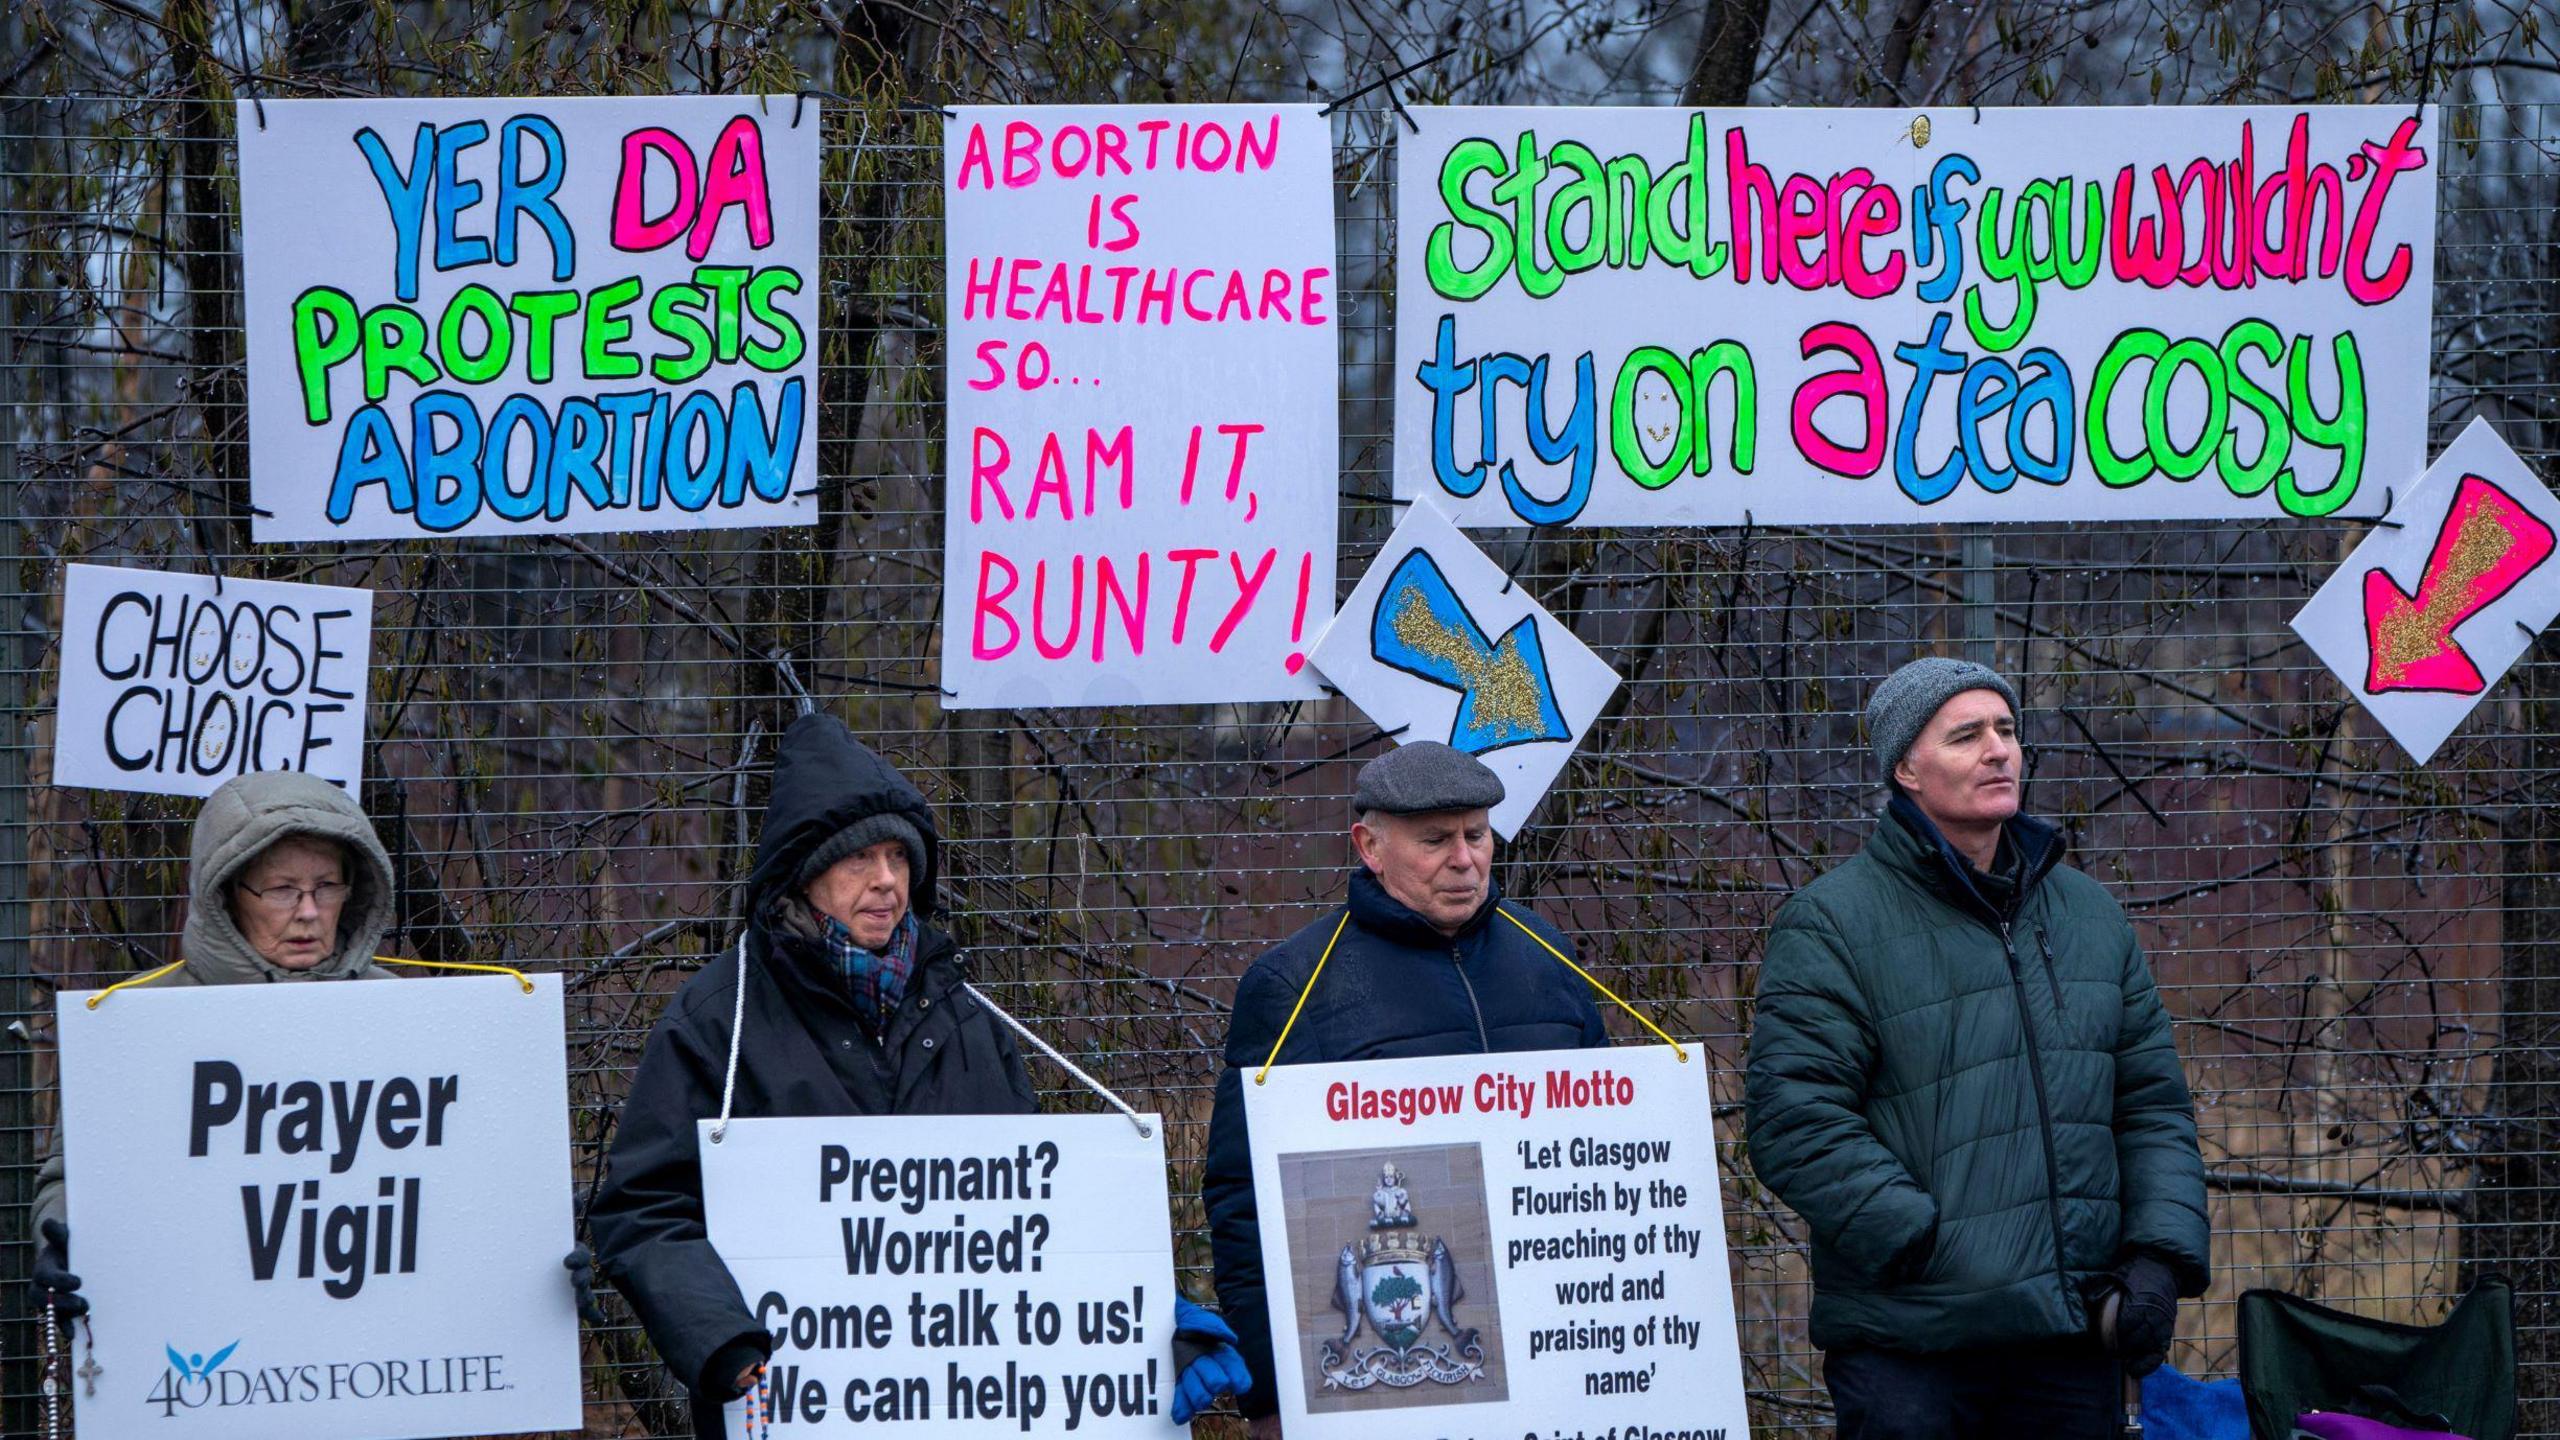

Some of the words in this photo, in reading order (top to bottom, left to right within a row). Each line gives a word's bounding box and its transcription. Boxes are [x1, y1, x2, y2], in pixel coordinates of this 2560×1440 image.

[957, 114, 1280, 189] ABORTION
[353, 114, 575, 302] YER
[610, 114, 774, 261] DA
[1088, 194, 1141, 252] IS
[1425, 111, 1729, 301] Stand
[1725, 127, 1907, 299] here
[1964, 175, 2106, 352] you
[2110, 113, 2428, 305] wouldn't
[964, 256, 1330, 325] HEALTHCARE
[292, 265, 806, 425] PROTESTS
[968, 340, 1101, 390] SO...
[326, 376, 805, 532] ABORTION
[1416, 313, 1598, 526] try
[1611, 338, 1758, 491] on
[1791, 321, 1890, 480] a
[1893, 312, 2076, 506] tea
[970, 425, 1134, 524] RAM
[1180, 424, 1265, 523] IT,
[95, 591, 354, 699] CHOOSE
[972, 547, 1312, 676] BUNTY!
[104, 685, 347, 788] CHOICE
[188, 1060, 458, 1174] Prayer
[1326, 1081, 1463, 1125] Glasgow
[1474, 1072, 1535, 1118] City
[1546, 1070, 1634, 1108] Motto
[819, 1141, 1059, 1215] Pregnant?
[1517, 1140, 1561, 1170] ‘Let
[1569, 1137, 1671, 1171] Glasgow
[1512, 1183, 1606, 1216] Flourish
[1614, 1182, 1641, 1217] by
[1648, 1179, 1687, 1209] the
[240, 1175, 421, 1300] Vigil
[841, 1213, 1050, 1275] Worried?
[1507, 1229, 1626, 1268] preaching
[1634, 1225, 1659, 1256] of
[1664, 1225, 1701, 1259] thy
[756, 1291, 893, 1351] Come
[908, 1288, 1000, 1348] talk
[1015, 1290, 1061, 1345] to
[1078, 1285, 1144, 1345] us!
[1555, 1273, 1614, 1305] word
[1621, 1270, 1665, 1301] and
[1376, 1368, 1423, 1385] GLASGOW
[1422, 1360, 1470, 1382] FLOURISH
[1530, 1321, 1625, 1359] praising
[1634, 1316, 1659, 1347] of
[1663, 1315, 1701, 1351] thy
[145, 1364, 212, 1418] 40
[767, 1365, 827, 1424] We
[844, 1375, 930, 1422] can
[946, 1361, 1046, 1432] help
[1061, 1358, 1158, 1430] you!
[1585, 1362, 1657, 1396] name’
